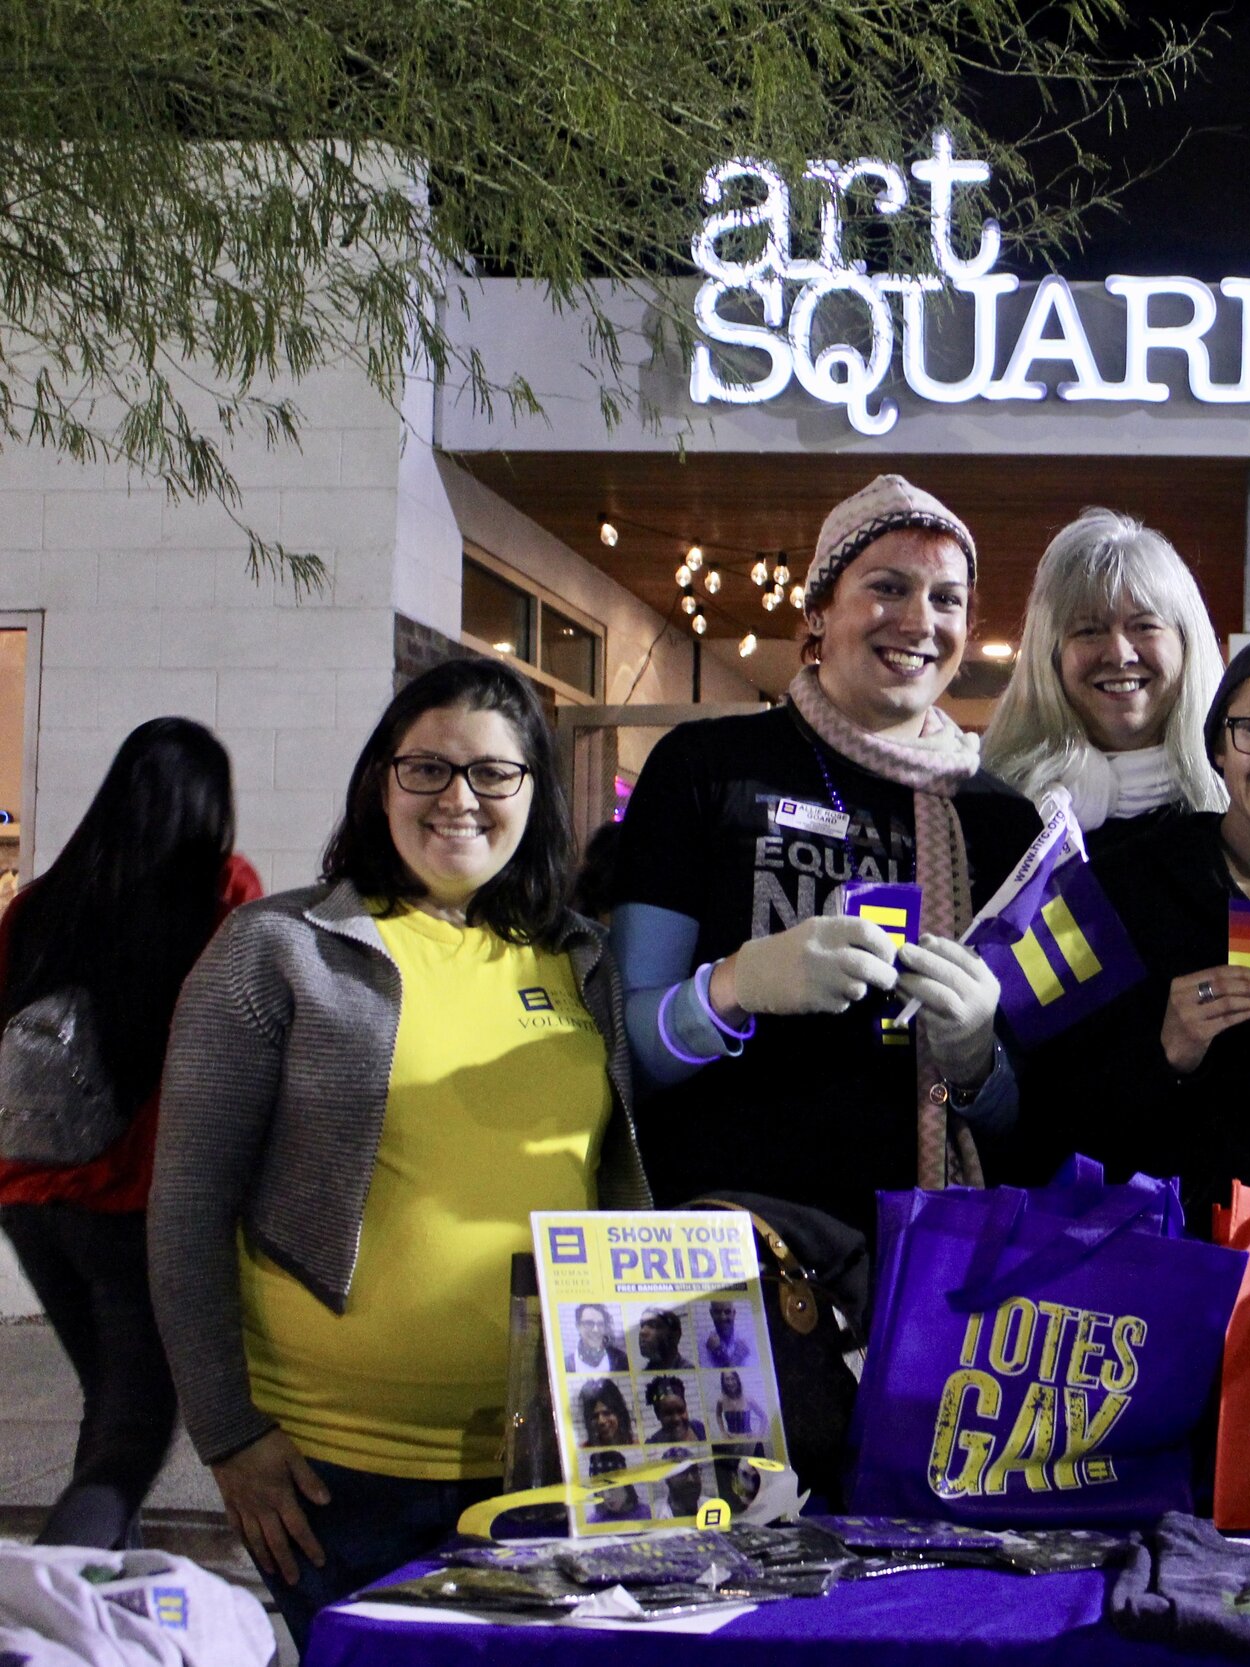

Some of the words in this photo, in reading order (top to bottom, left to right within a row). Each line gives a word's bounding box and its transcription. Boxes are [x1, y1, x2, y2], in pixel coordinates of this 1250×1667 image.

[691, 128, 1001, 280] art
[1014, 809, 1067, 883] www.hrc.org
[607, 1226, 673, 1243] SHOW
[681, 1227, 741, 1243] YOUR
[609, 1247, 746, 1281] PRIDE
[927, 1368, 1132, 1499] GAY
